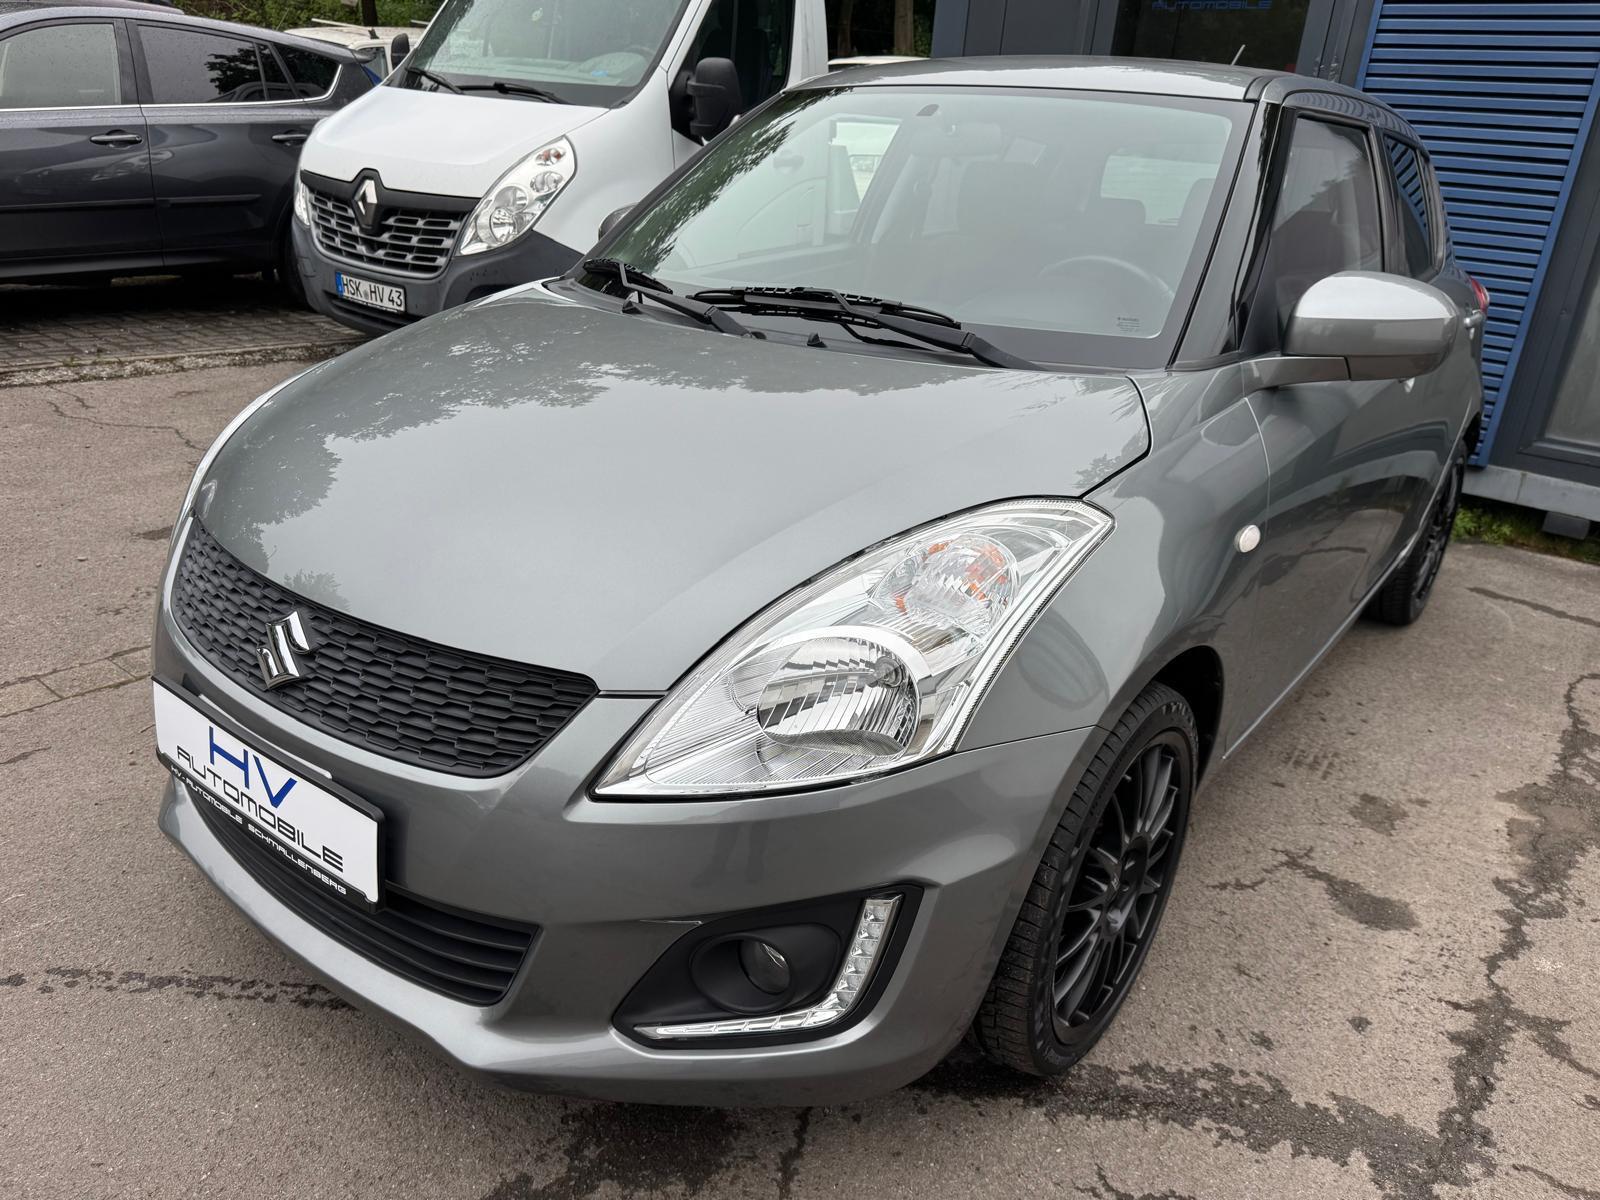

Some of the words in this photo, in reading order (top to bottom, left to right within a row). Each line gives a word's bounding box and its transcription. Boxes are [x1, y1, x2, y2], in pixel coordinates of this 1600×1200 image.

[1151, 0, 1272, 10] AUTOMOBILE
[341, 276, 362, 298] HSK
[369, 284, 384, 303] HV
[388, 289, 402, 307] 43
[208, 726, 298, 809] HV
[177, 745, 344, 873] AUTOMOBILE
[248, 823, 347, 895] SCHMALLENBERG
